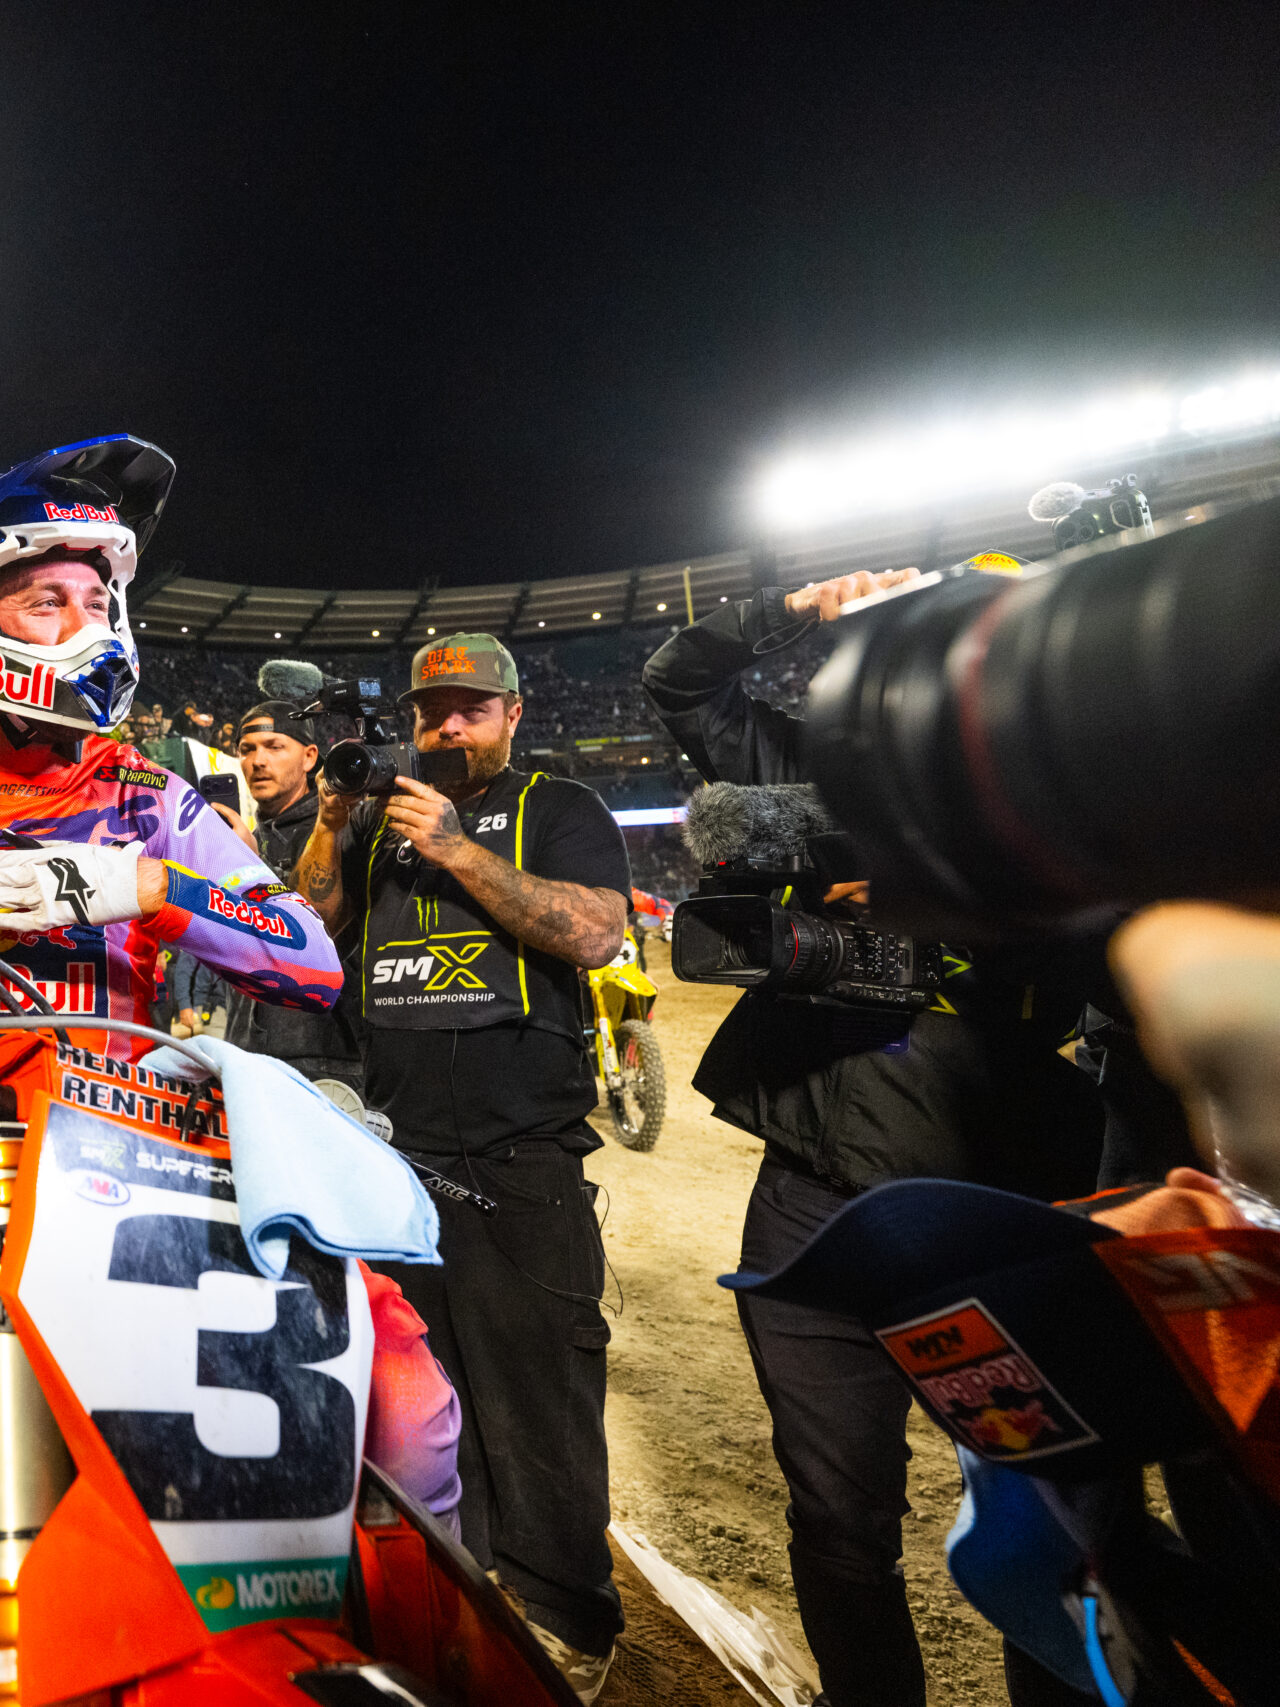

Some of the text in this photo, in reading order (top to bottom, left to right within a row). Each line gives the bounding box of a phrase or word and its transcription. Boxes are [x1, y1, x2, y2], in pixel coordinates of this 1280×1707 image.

[421, 659, 477, 681] SHARK
[476, 812, 508, 834] 26
[372, 942, 489, 991] SMX
[374, 993, 495, 1006] WORLD CHAMPIONSHIP
[61, 1071, 229, 1142] RENTHAL
[422, 1176, 470, 1201] ARC
[90, 1214, 356, 1522] 3
[237, 1568, 340, 1609] MOTOREX
